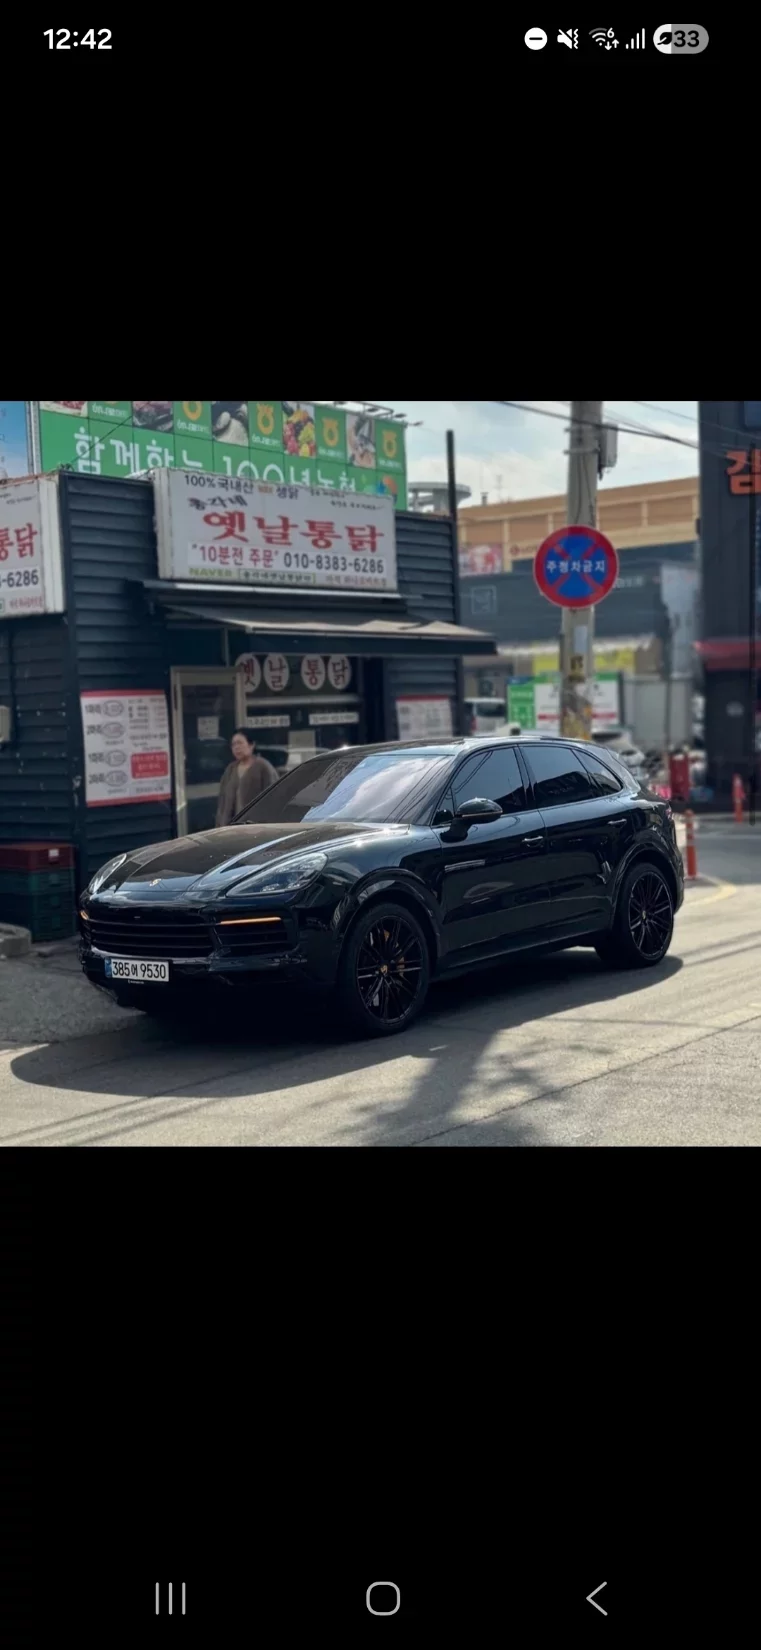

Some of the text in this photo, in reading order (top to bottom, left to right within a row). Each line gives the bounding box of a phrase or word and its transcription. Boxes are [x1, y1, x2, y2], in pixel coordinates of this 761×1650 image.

[203, 510, 384, 553] 옛날통닭
[284, 552, 385, 574] 010-8383-6286
[546, 559, 606, 574] 주정차금지
[140, 963, 166, 979] 9530
